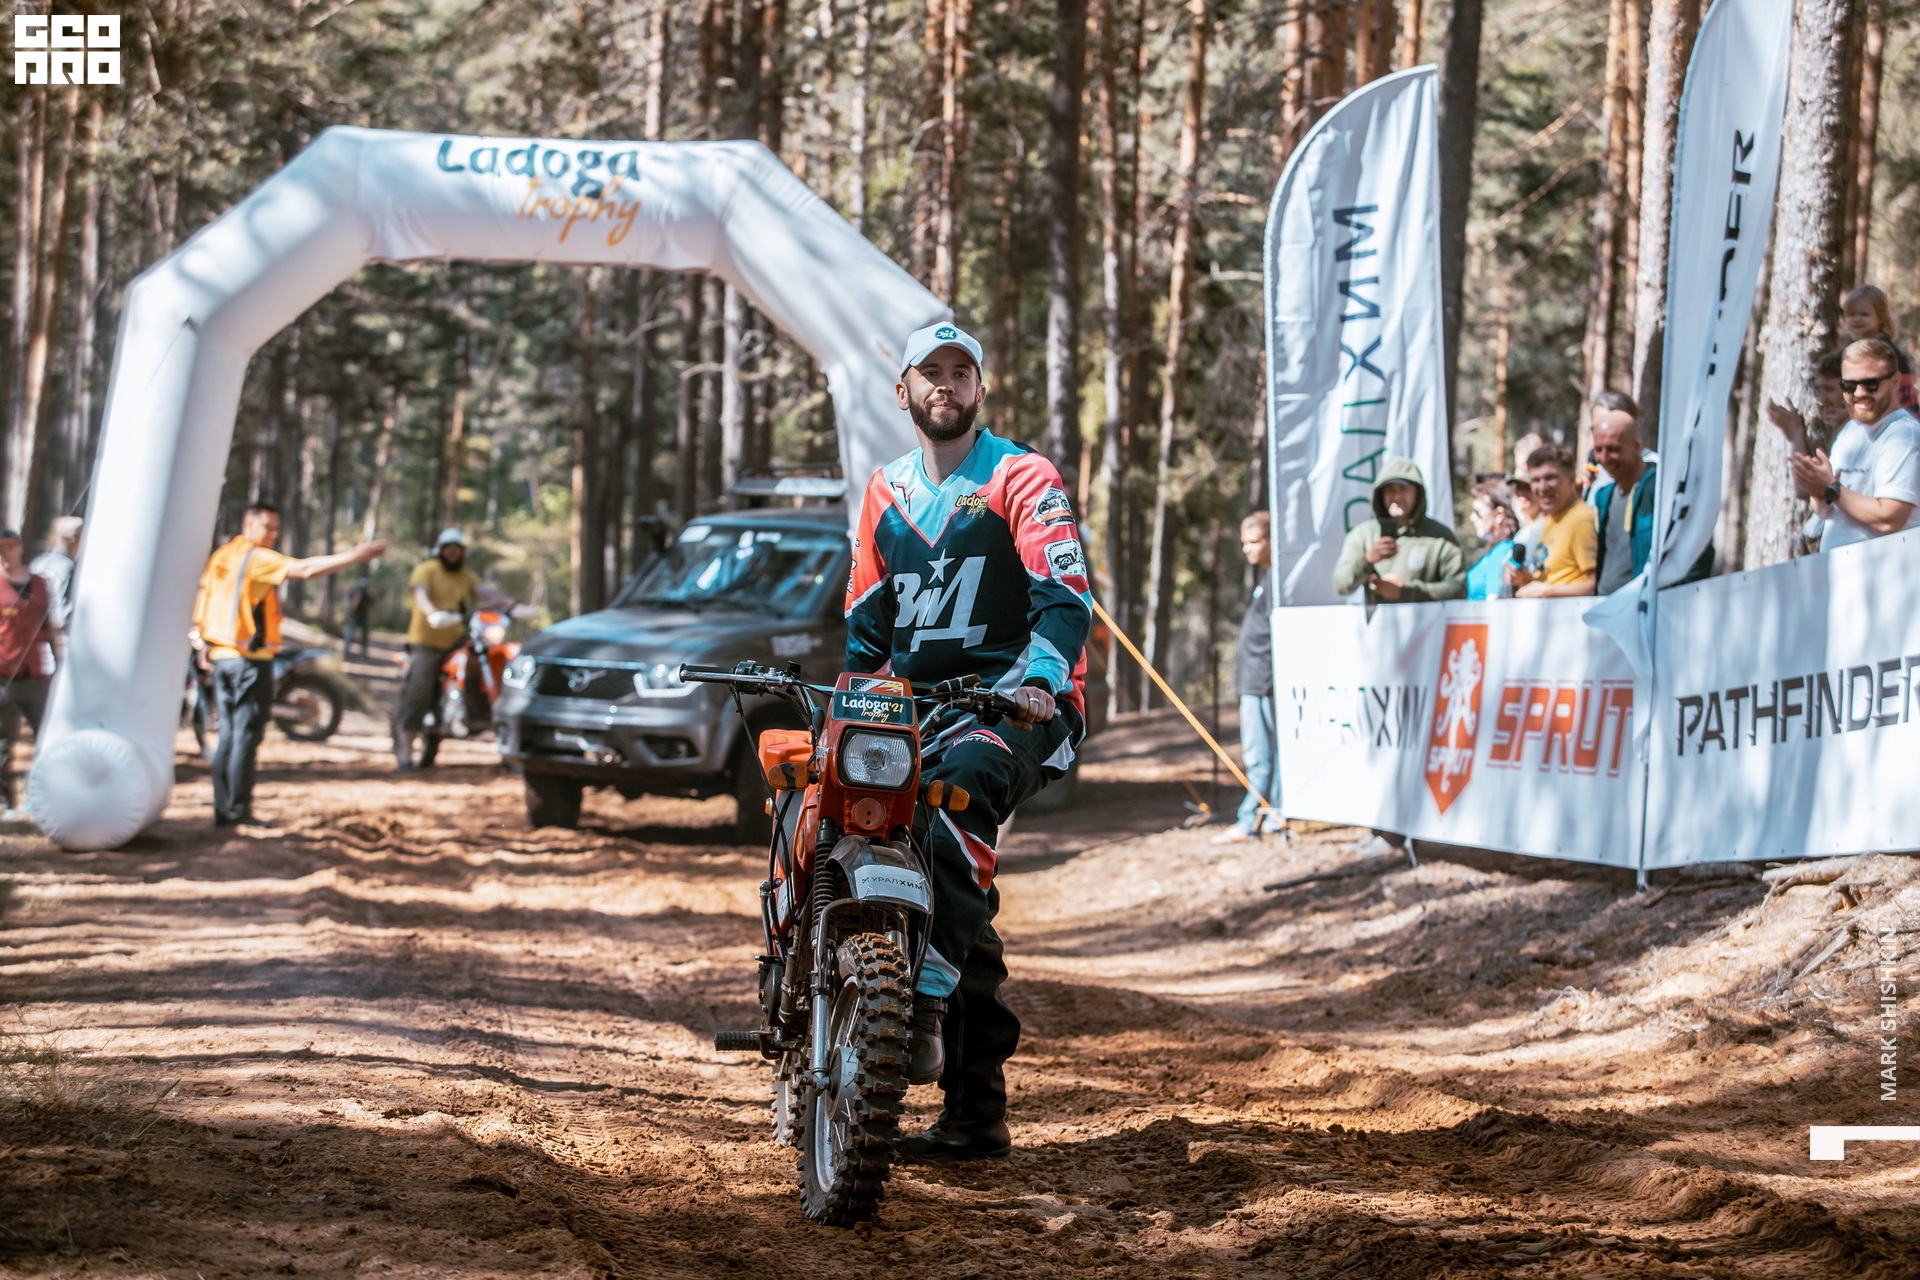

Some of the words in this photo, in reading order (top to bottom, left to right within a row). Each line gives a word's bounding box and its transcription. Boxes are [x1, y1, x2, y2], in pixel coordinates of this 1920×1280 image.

[437, 140, 640, 199] Ladoga
[1485, 679, 1634, 778] SPRUT
[871, 876, 923, 891] УРАЛХИМ
